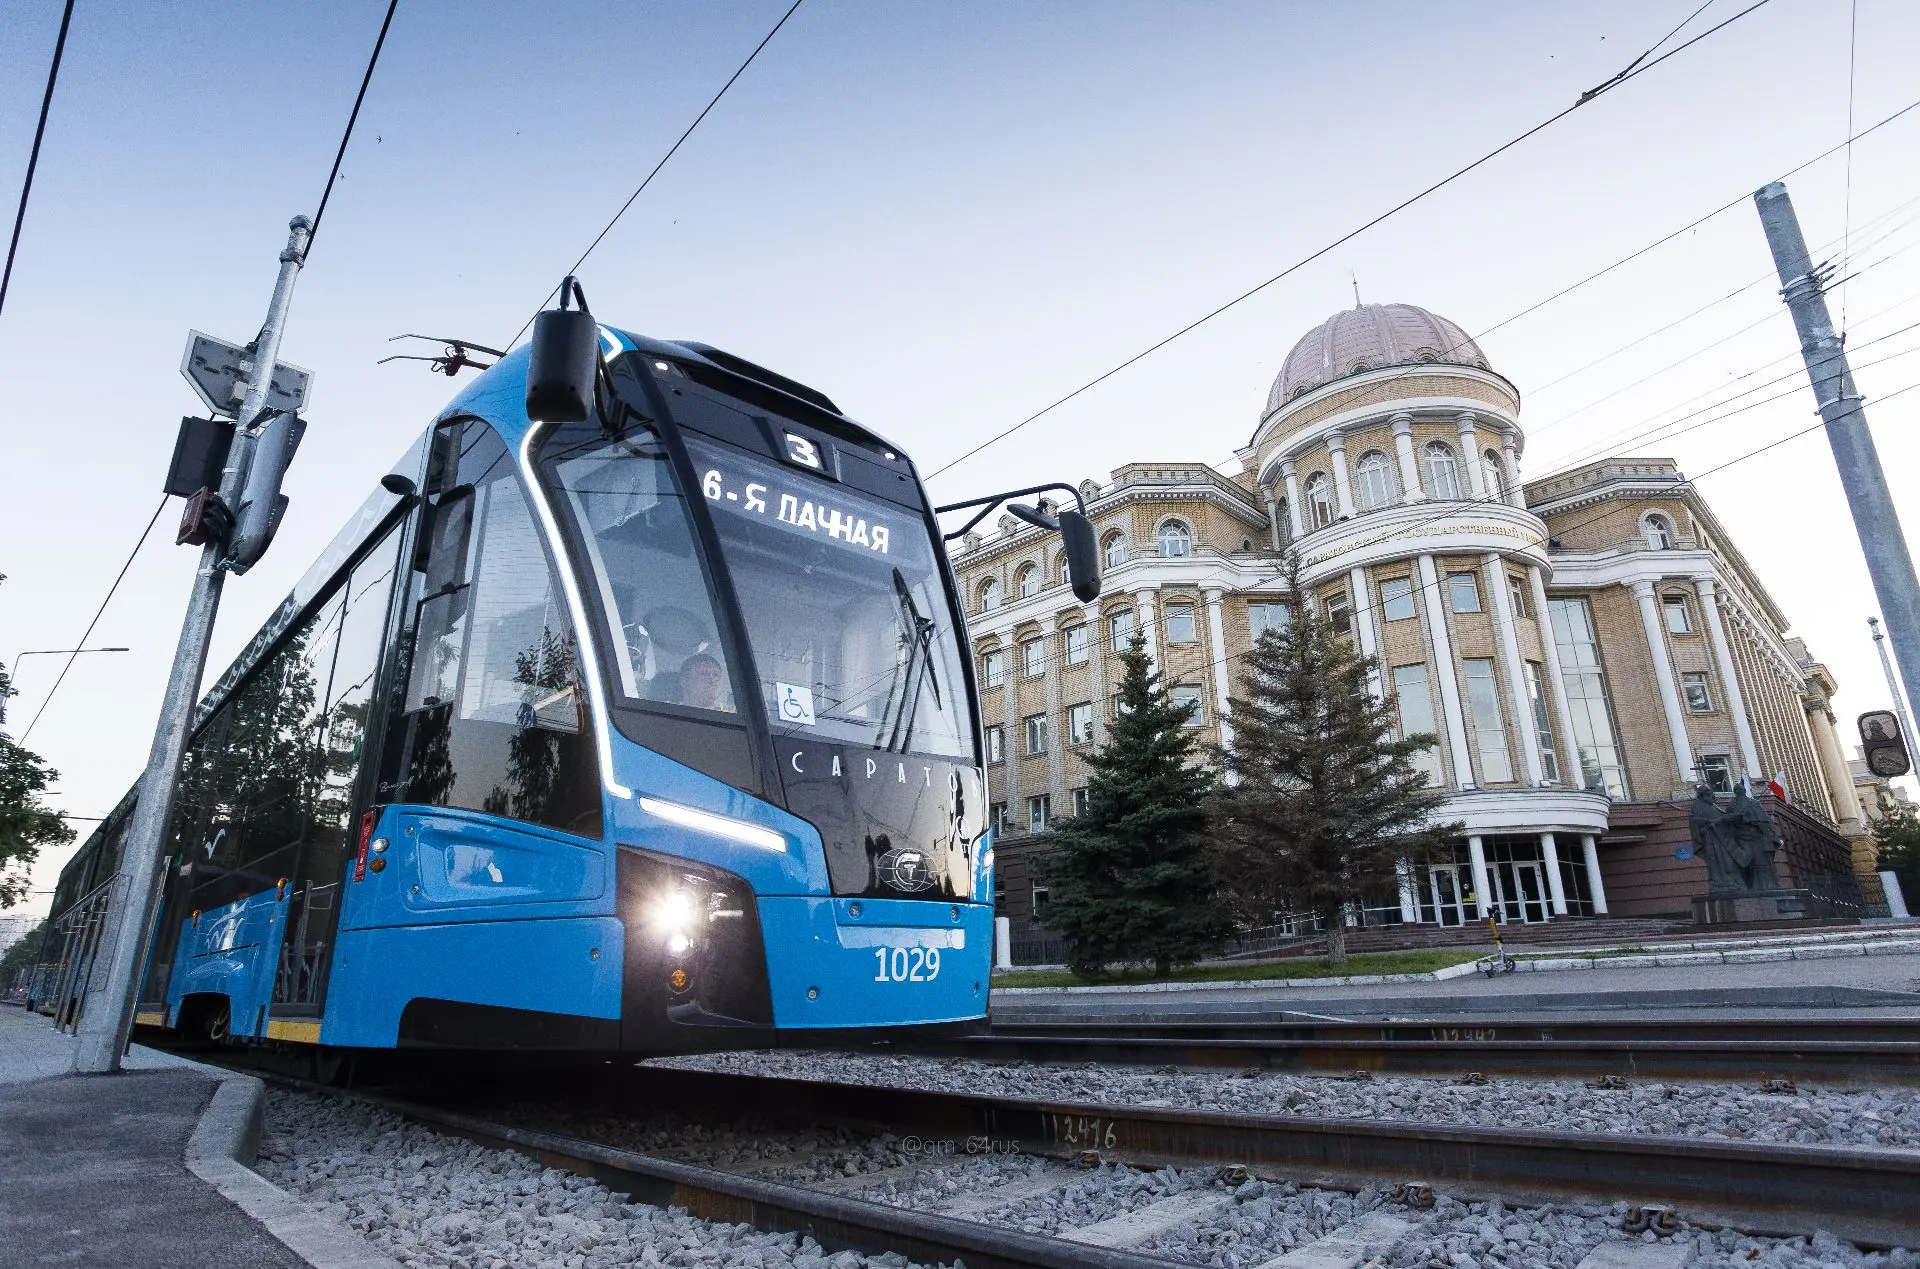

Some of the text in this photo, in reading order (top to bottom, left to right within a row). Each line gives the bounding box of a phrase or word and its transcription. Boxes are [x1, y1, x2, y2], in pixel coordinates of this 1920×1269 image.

[786, 433, 819, 469] 3
[776, 493, 889, 554] ДАЧНАЯ
[874, 947, 940, 982] 1029
